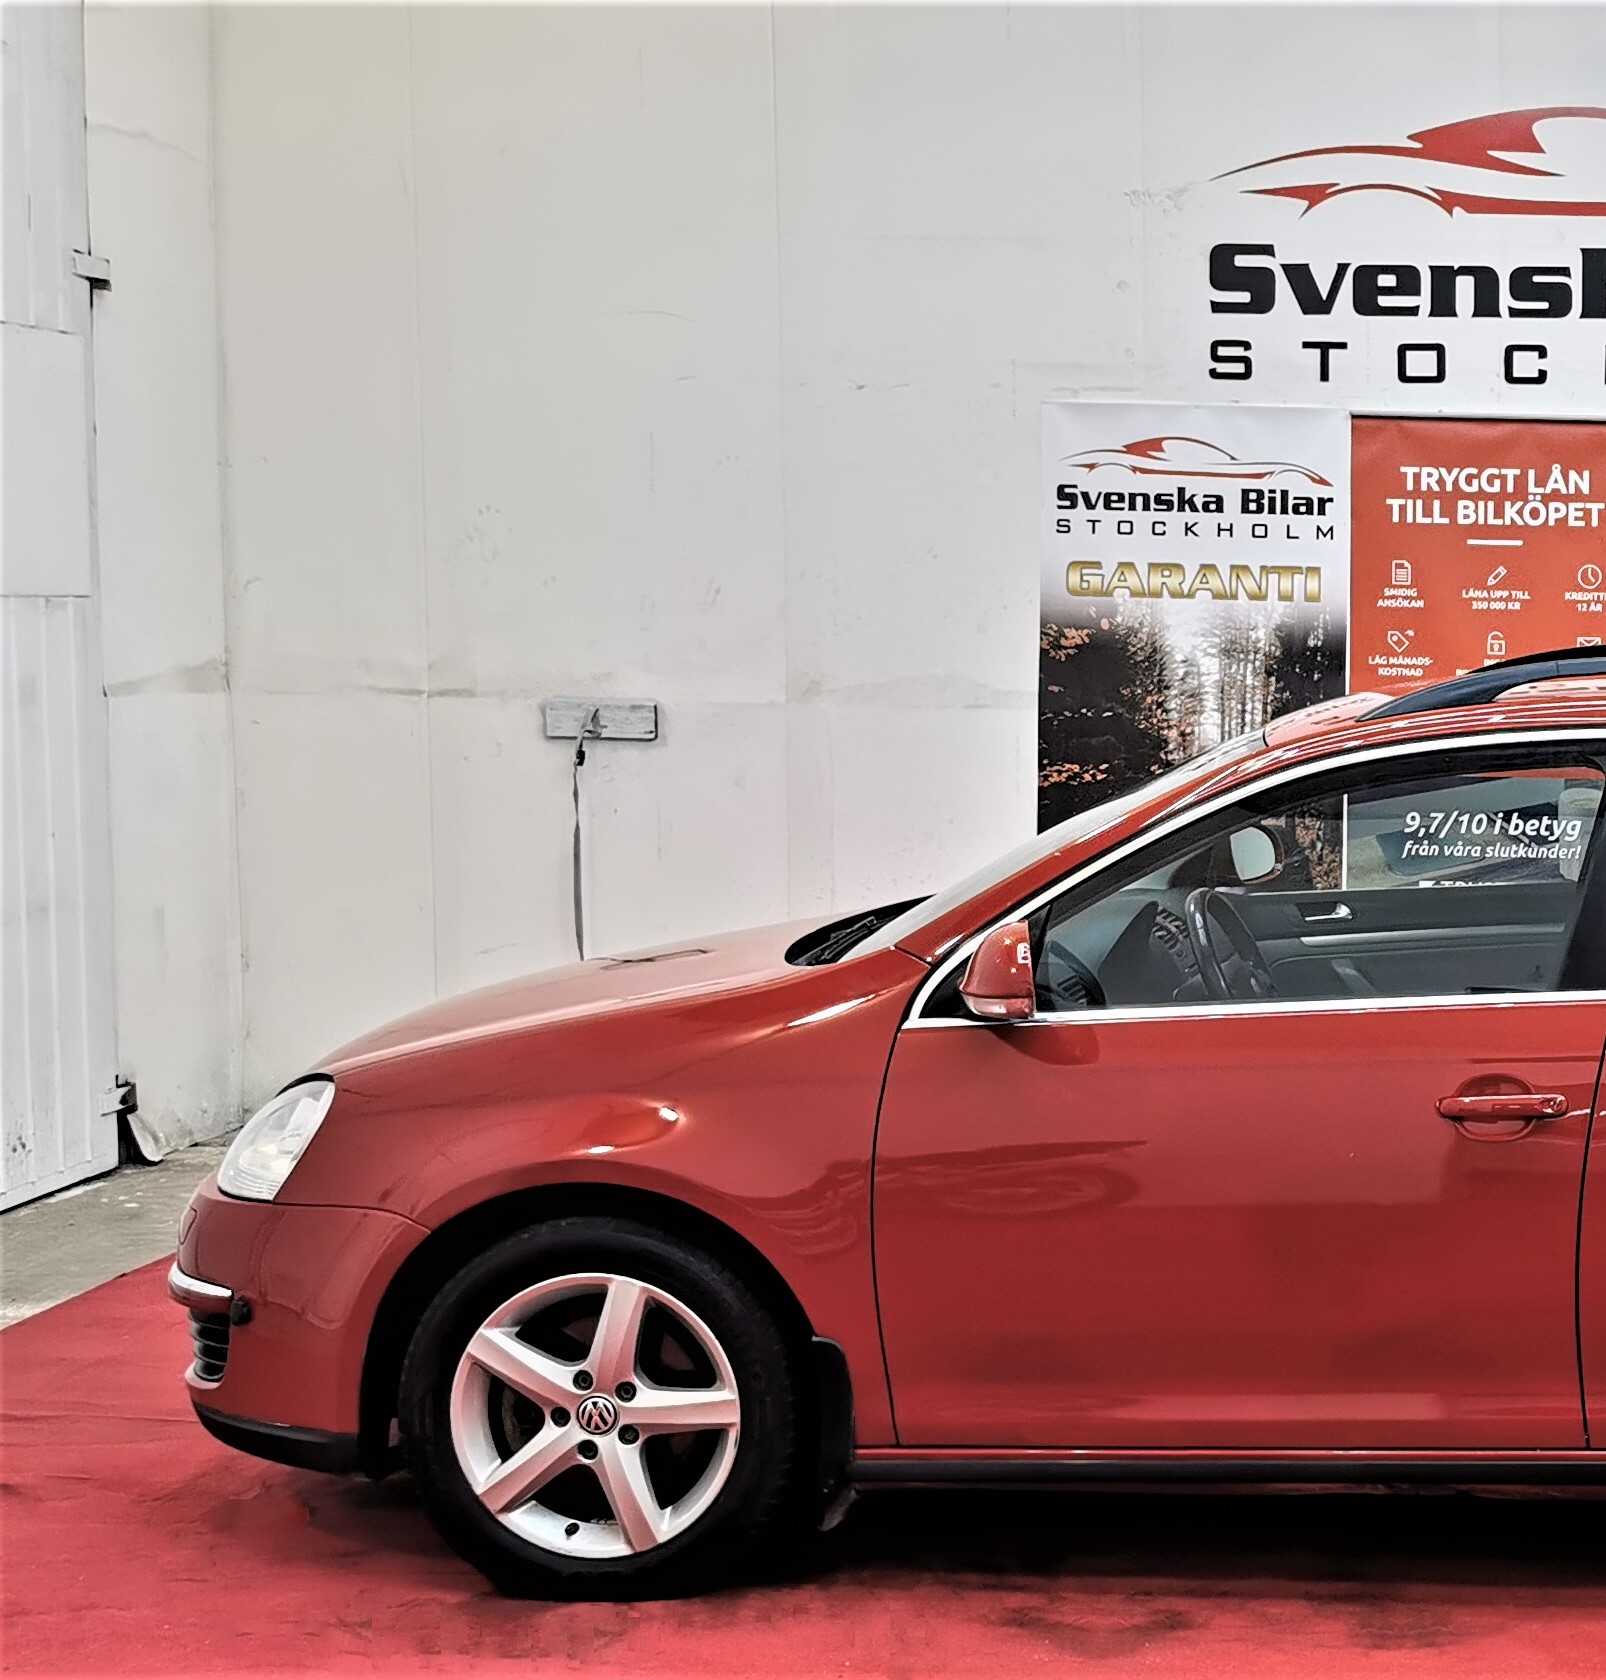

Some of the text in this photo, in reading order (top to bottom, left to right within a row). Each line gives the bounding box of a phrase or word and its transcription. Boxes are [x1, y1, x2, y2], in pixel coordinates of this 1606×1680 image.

[1400, 464, 1590, 494] TRYGGT LÅN
[1056, 484, 1334, 516] Svenska Bilar
[1386, 495, 1605, 527] TILL BILKÖPET
[1055, 519, 1334, 540] STOCKHOLM
[1066, 561, 1322, 603] GARANTI
[1384, 587, 1418, 597] SMIDIG
[1462, 588, 1531, 600] LÅNA UPP TILL
[1376, 597, 1425, 608] ANSÖKAN
[1471, 601, 1488, 610] 350
[1576, 602, 1603, 612] 12 ÅR
[1368, 654, 1387, 665] LÅG
[1378, 667, 1424, 677] KOSTNAD
[1403, 811, 1582, 842] 9,7/10 i betyg
[1402, 841, 1582, 859] från våra slutkunder!
